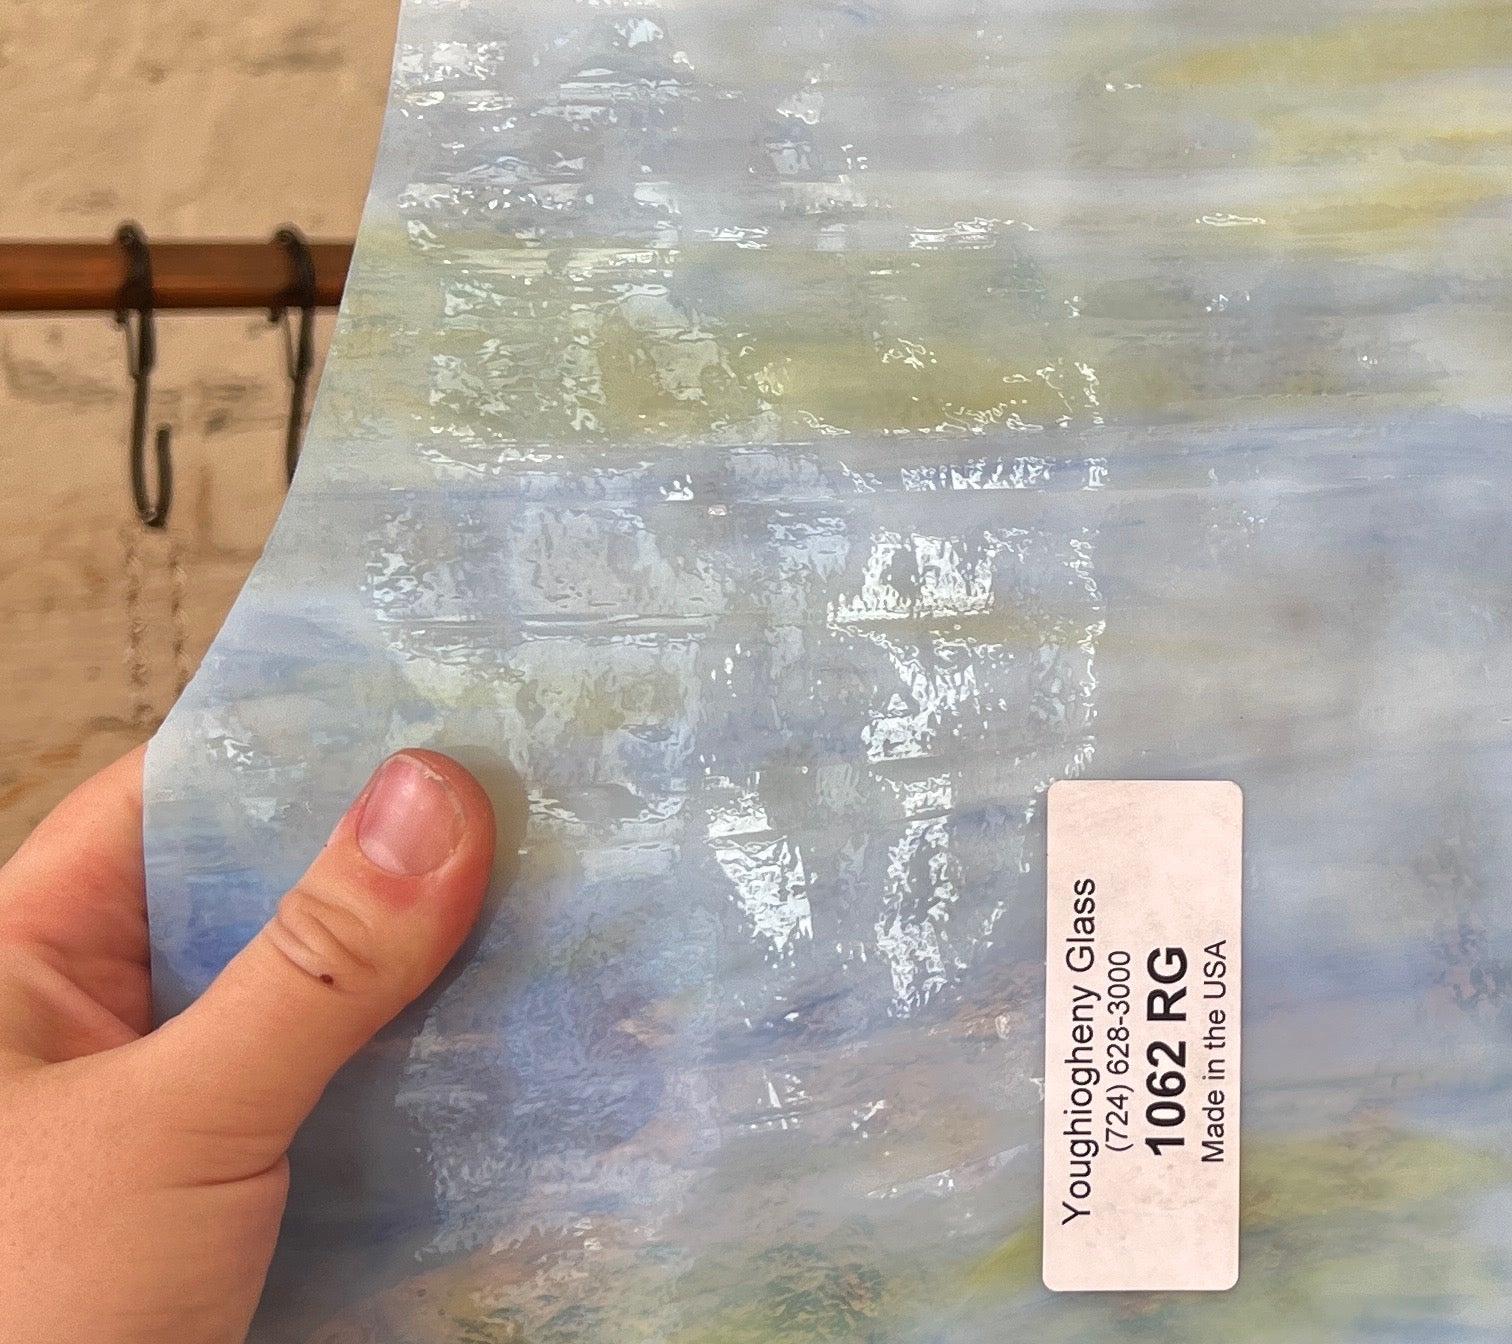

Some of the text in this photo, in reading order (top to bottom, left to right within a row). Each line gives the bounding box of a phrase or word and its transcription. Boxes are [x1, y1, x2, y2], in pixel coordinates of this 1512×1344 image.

[1061, 878, 1102, 1226] Youghiogheny Glass
[1104, 950, 1135, 1152] (724) 628-3000
[1144, 947, 1188, 1157] 1062 RG
[1201, 939, 1227, 1163] Made in the USA
